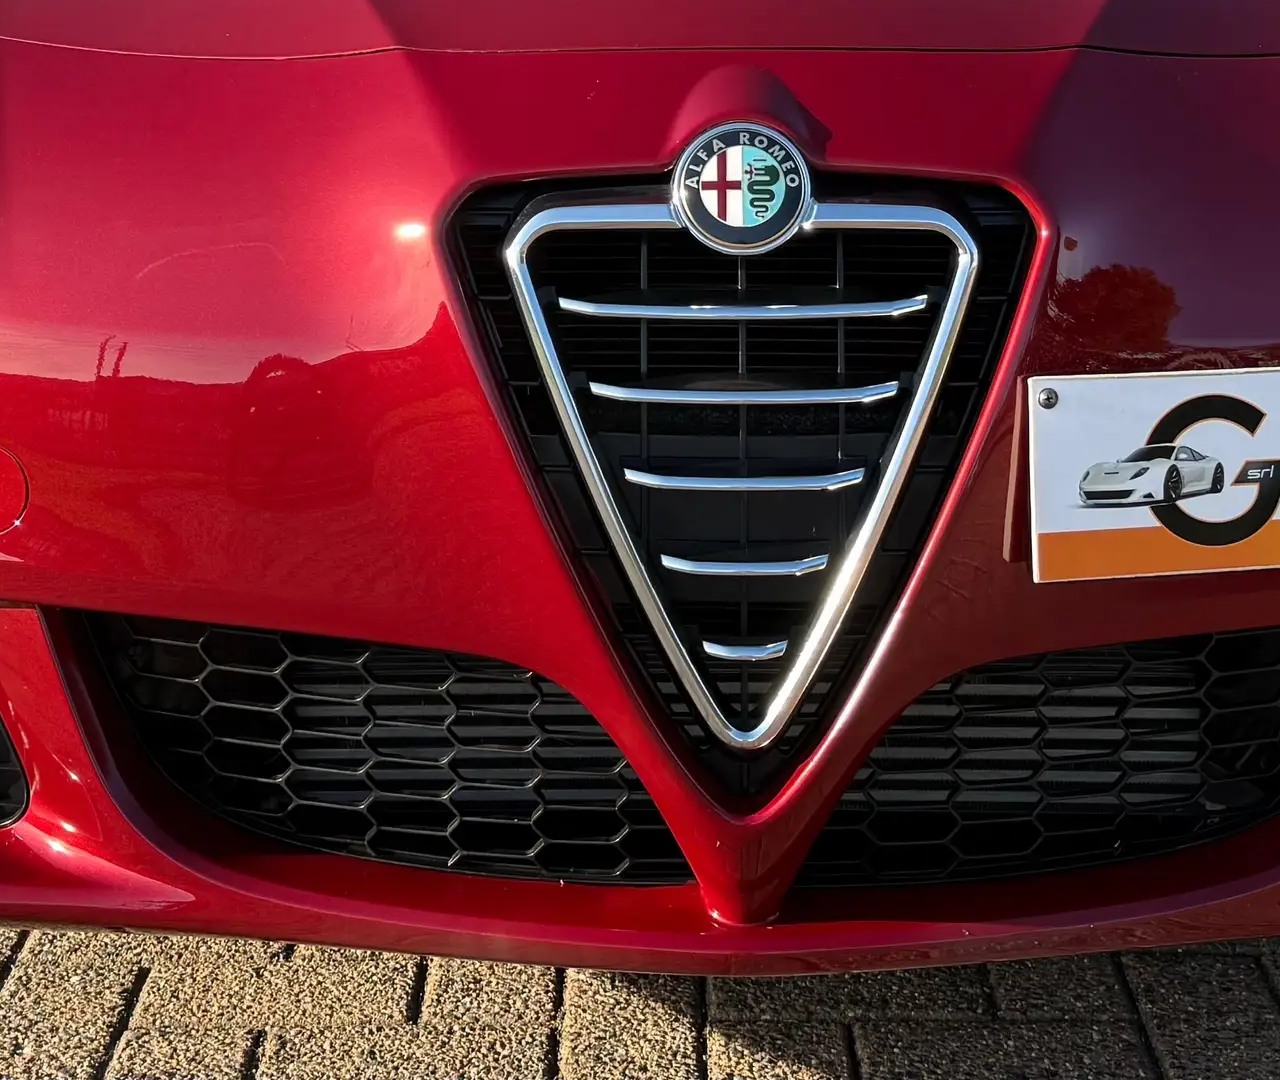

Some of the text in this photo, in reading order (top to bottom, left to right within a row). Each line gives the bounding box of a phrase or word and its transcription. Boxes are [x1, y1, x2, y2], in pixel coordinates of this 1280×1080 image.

[685, 131, 800, 190] ALFA ROMEO
[1247, 464, 1275, 479] srl
